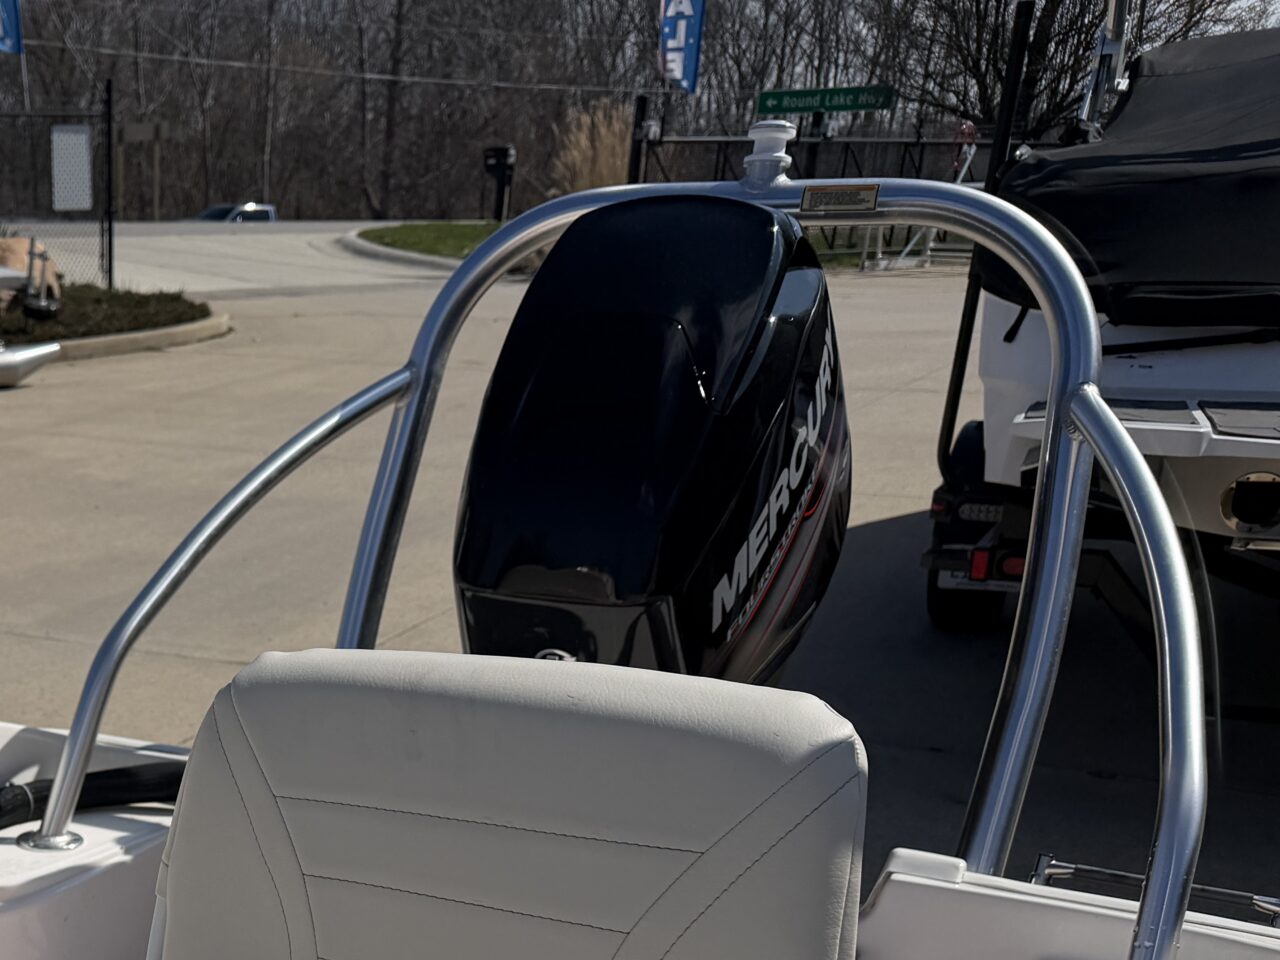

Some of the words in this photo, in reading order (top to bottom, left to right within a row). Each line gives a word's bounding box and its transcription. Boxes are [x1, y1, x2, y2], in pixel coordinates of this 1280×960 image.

[782, 94, 820, 108] Round
[825, 94, 854, 107] Lake
[858, 93, 884, 107] Hwy
[711, 322, 834, 632] MERCURY
